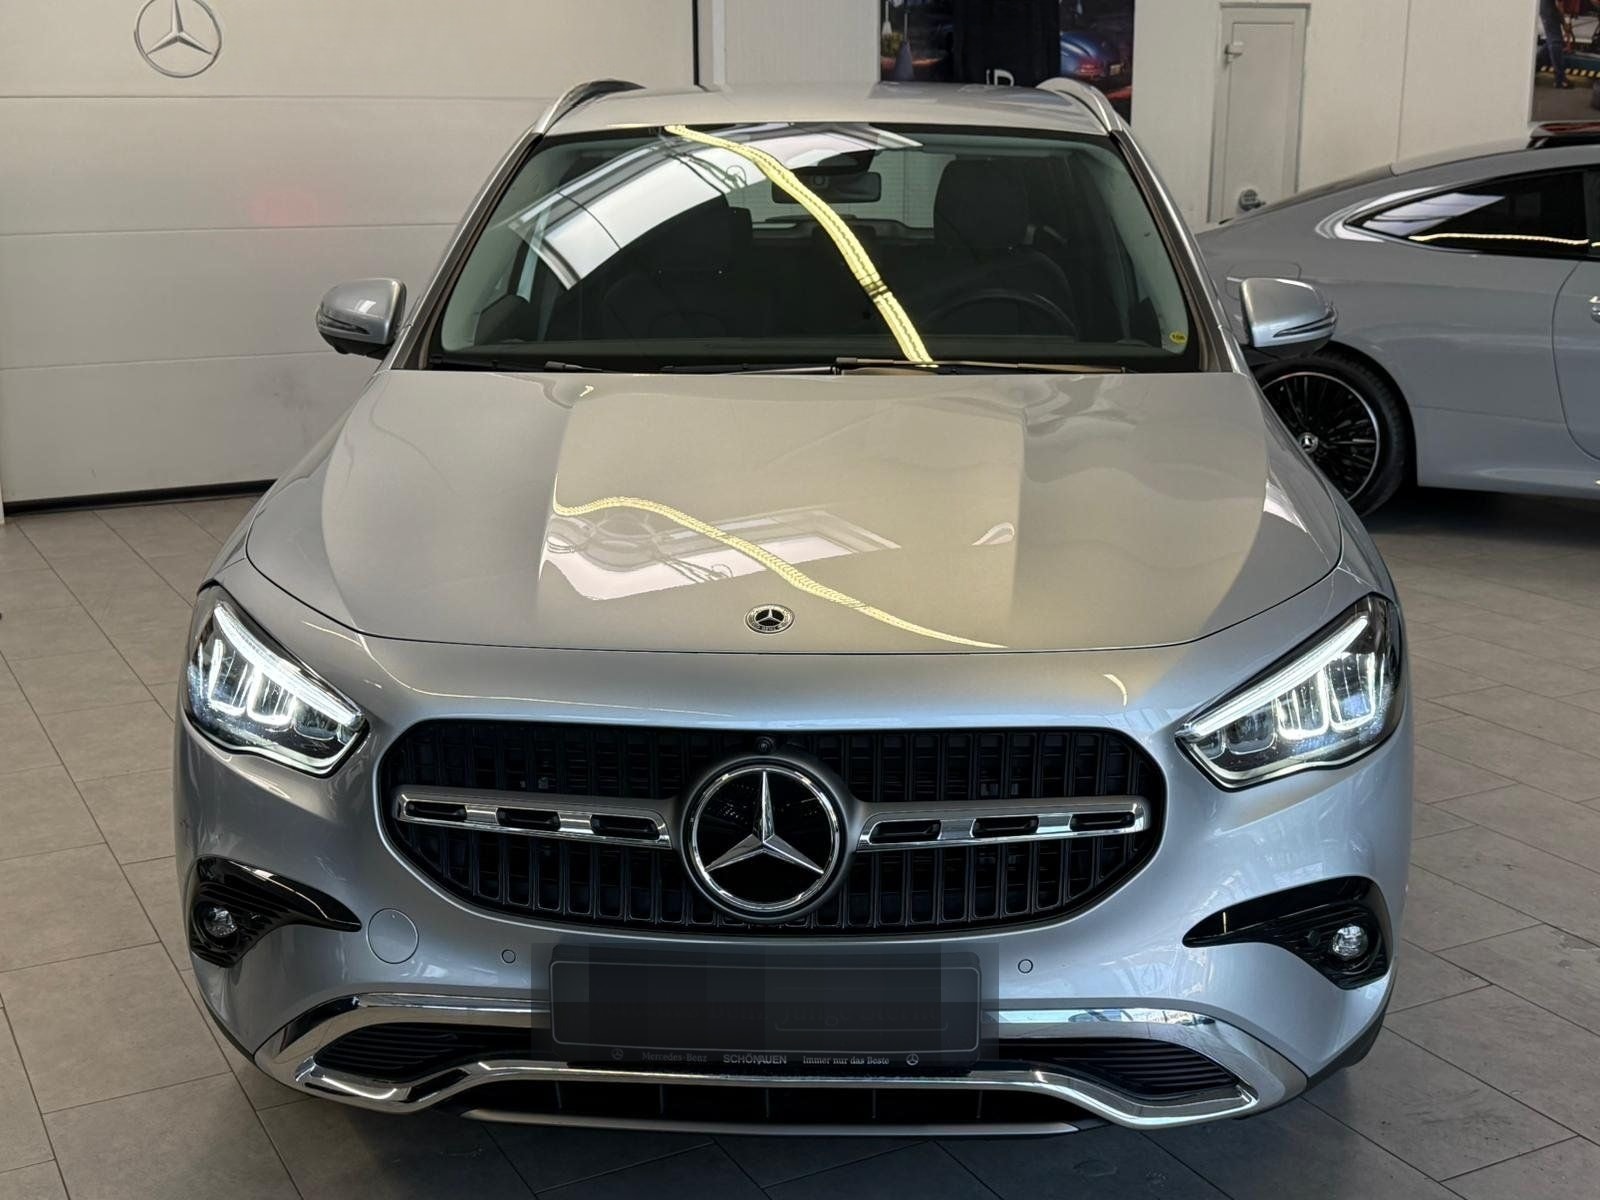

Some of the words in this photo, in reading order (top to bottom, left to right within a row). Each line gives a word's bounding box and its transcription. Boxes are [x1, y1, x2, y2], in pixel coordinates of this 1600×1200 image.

[803, 1055, 831, 1065] Immer
[833, 1056, 848, 1065] nur
[850, 1055, 864, 1065] das
[866, 1055, 889, 1065] Beste
